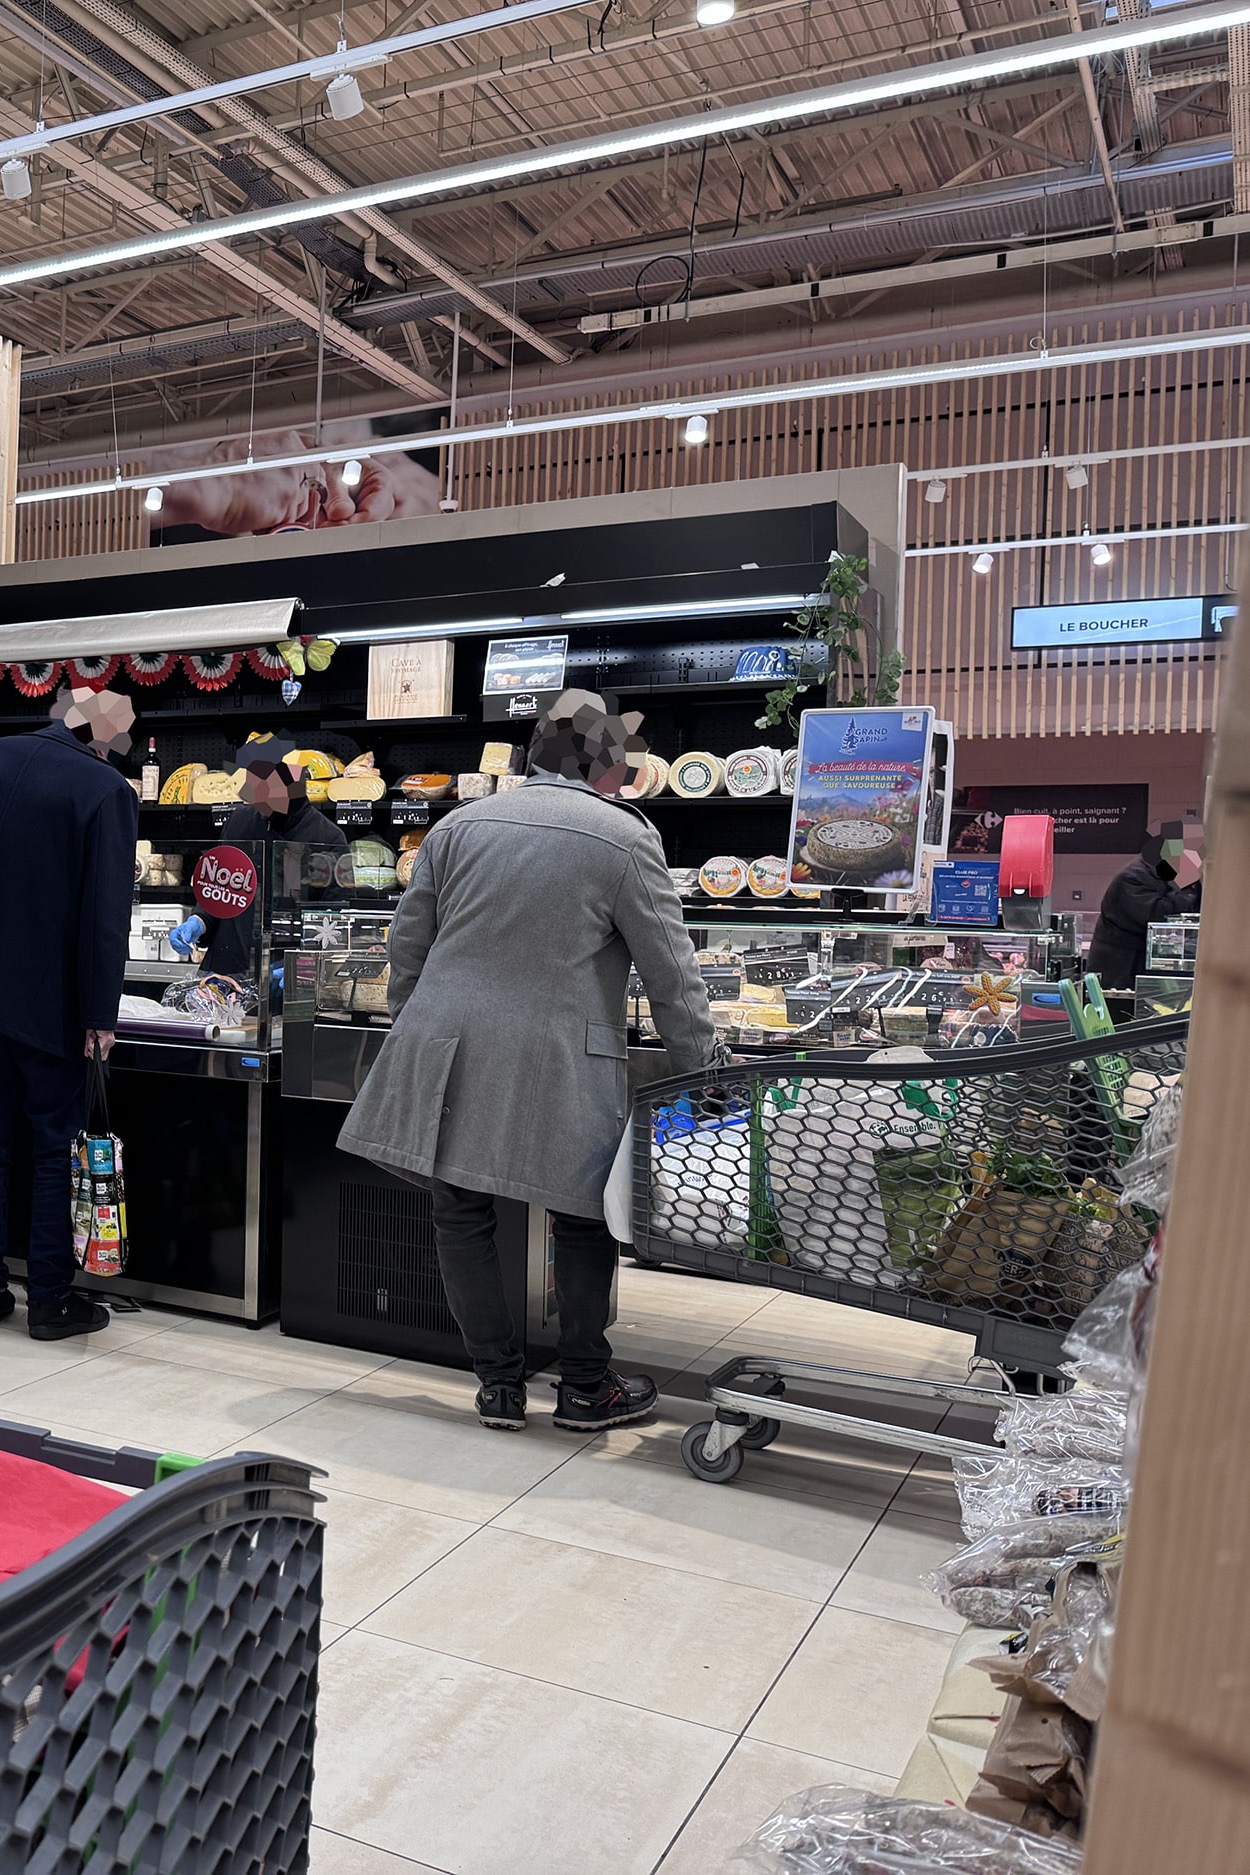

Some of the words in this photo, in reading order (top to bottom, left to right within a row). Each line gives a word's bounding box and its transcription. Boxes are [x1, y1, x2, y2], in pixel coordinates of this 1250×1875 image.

[1059, 622, 1075, 632] LE
[1079, 618, 1149, 631] BOUCHER
[855, 727, 888, 736] GRAND
[842, 781, 896, 789] SAVOUREUSE
[1059, 807, 1082, 816] point,
[1084, 807, 1119, 816] saignant
[1054, 816, 1072, 824] cher
[1099, 817, 1119, 825] pour
[202, 886, 247, 908] GOÛTS
